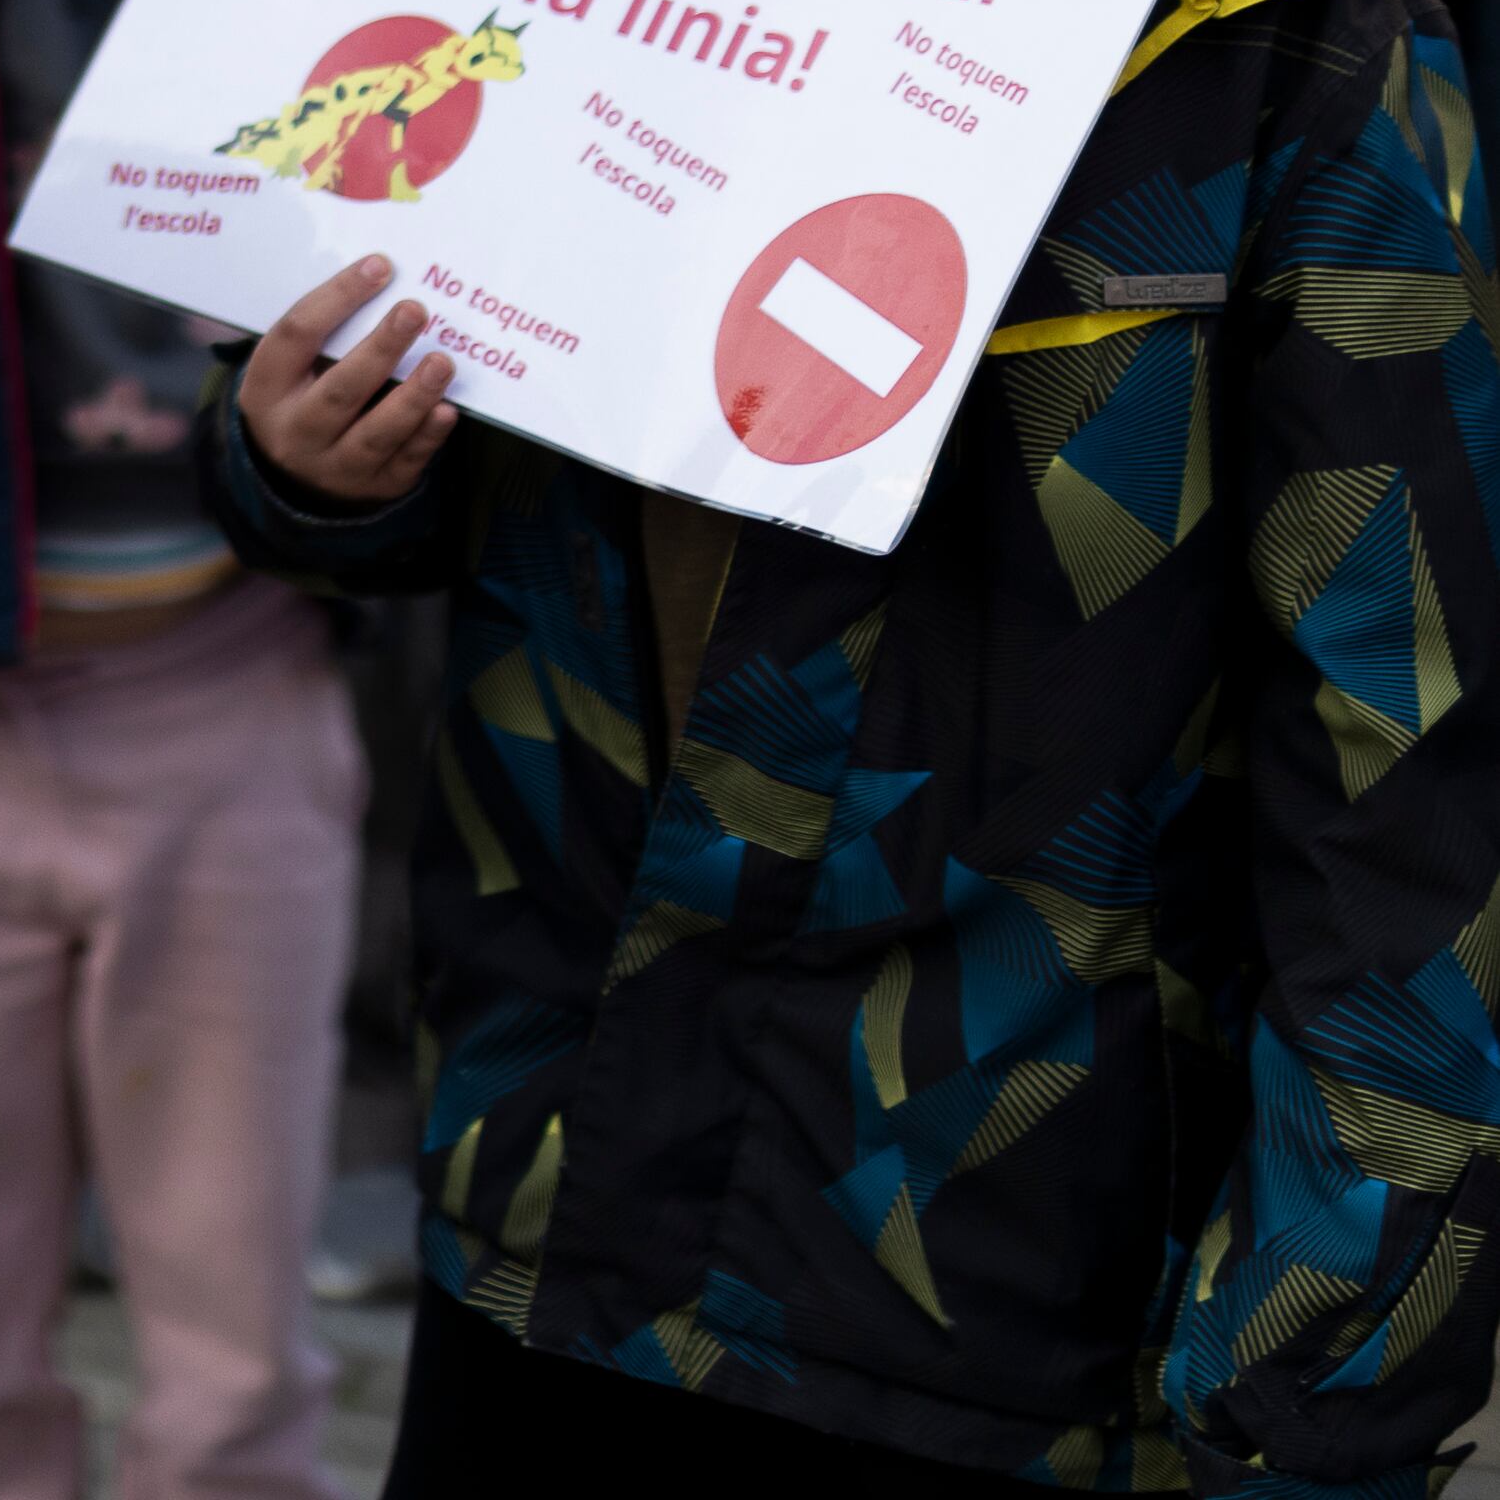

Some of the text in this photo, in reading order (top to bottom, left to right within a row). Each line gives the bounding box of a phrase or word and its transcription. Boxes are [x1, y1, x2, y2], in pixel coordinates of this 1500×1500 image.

[894, 20, 1030, 105] No toquem
[889, 72, 979, 135] l'escola
[583, 91, 728, 192] No toquem
[108, 162, 261, 197] No toquem
[578, 142, 676, 216] l'escola
[121, 204, 222, 236] l'escola
[421, 263, 580, 354] No toquem
